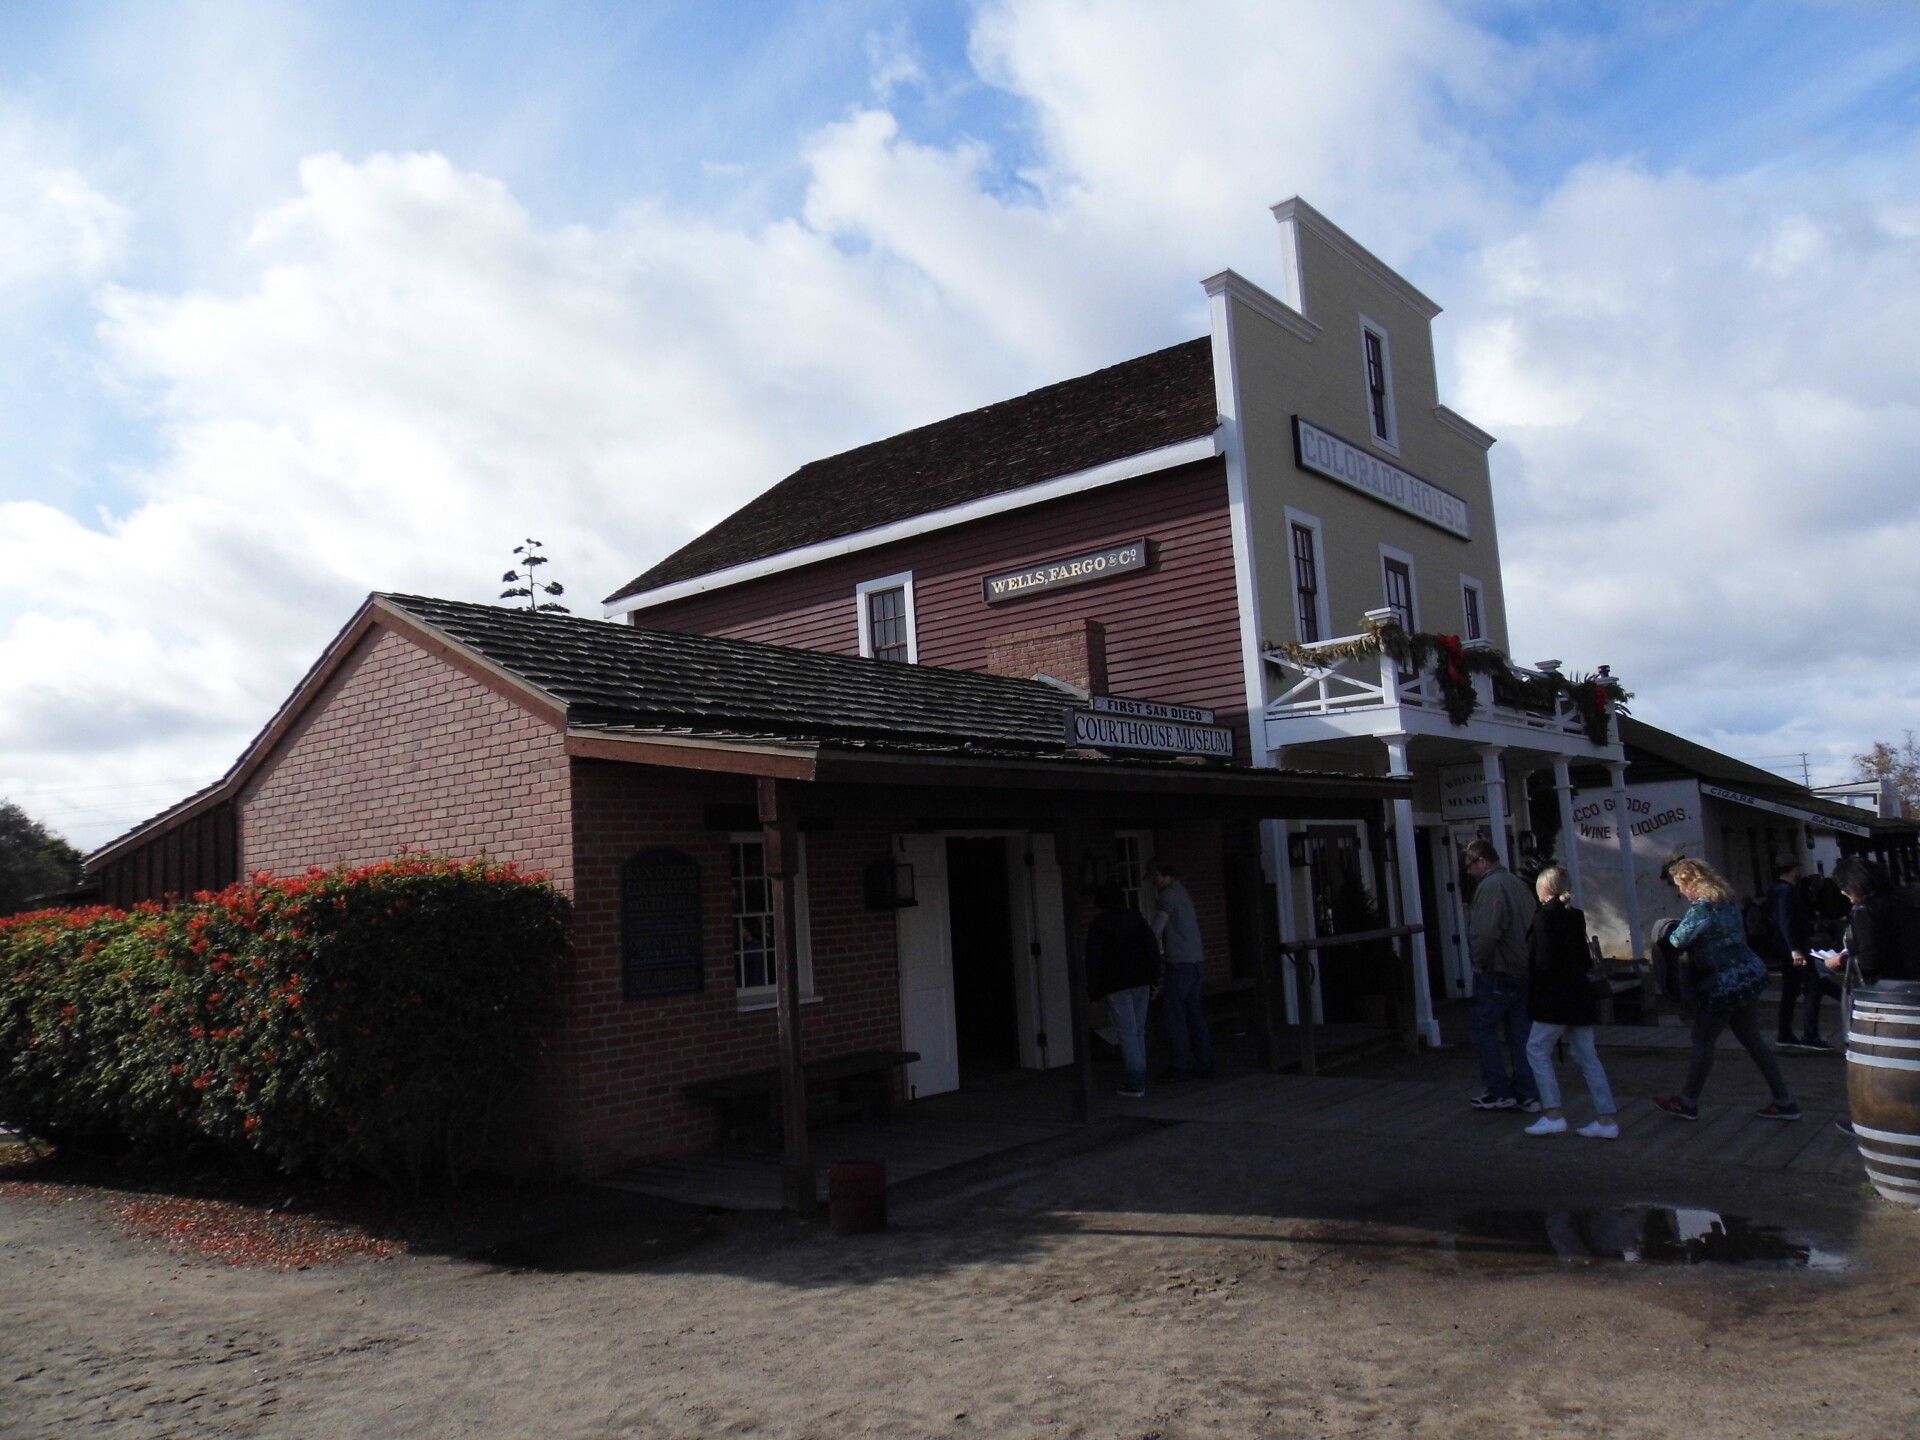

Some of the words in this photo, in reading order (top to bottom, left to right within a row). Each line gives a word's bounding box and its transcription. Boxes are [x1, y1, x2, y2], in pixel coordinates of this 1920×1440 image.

[1303, 427, 1405, 503] COLORADO
[1410, 479, 1464, 530] HOUSE
[1048, 557, 1106, 581] FARGO
[1107, 553, 1118, 567] &
[1107, 699, 1142, 714] FIRST
[1146, 705, 1168, 717] SAN
[1171, 708, 1202, 721] DIEGO
[1075, 716, 1175, 747] COURTHOUSE
[1710, 787, 1754, 804] CIGARS
[1580, 824, 1611, 839] WINE
[1811, 815, 1859, 832] SALOON
[626, 866, 651, 880] SAN
[655, 865, 696, 879] DIEGO
